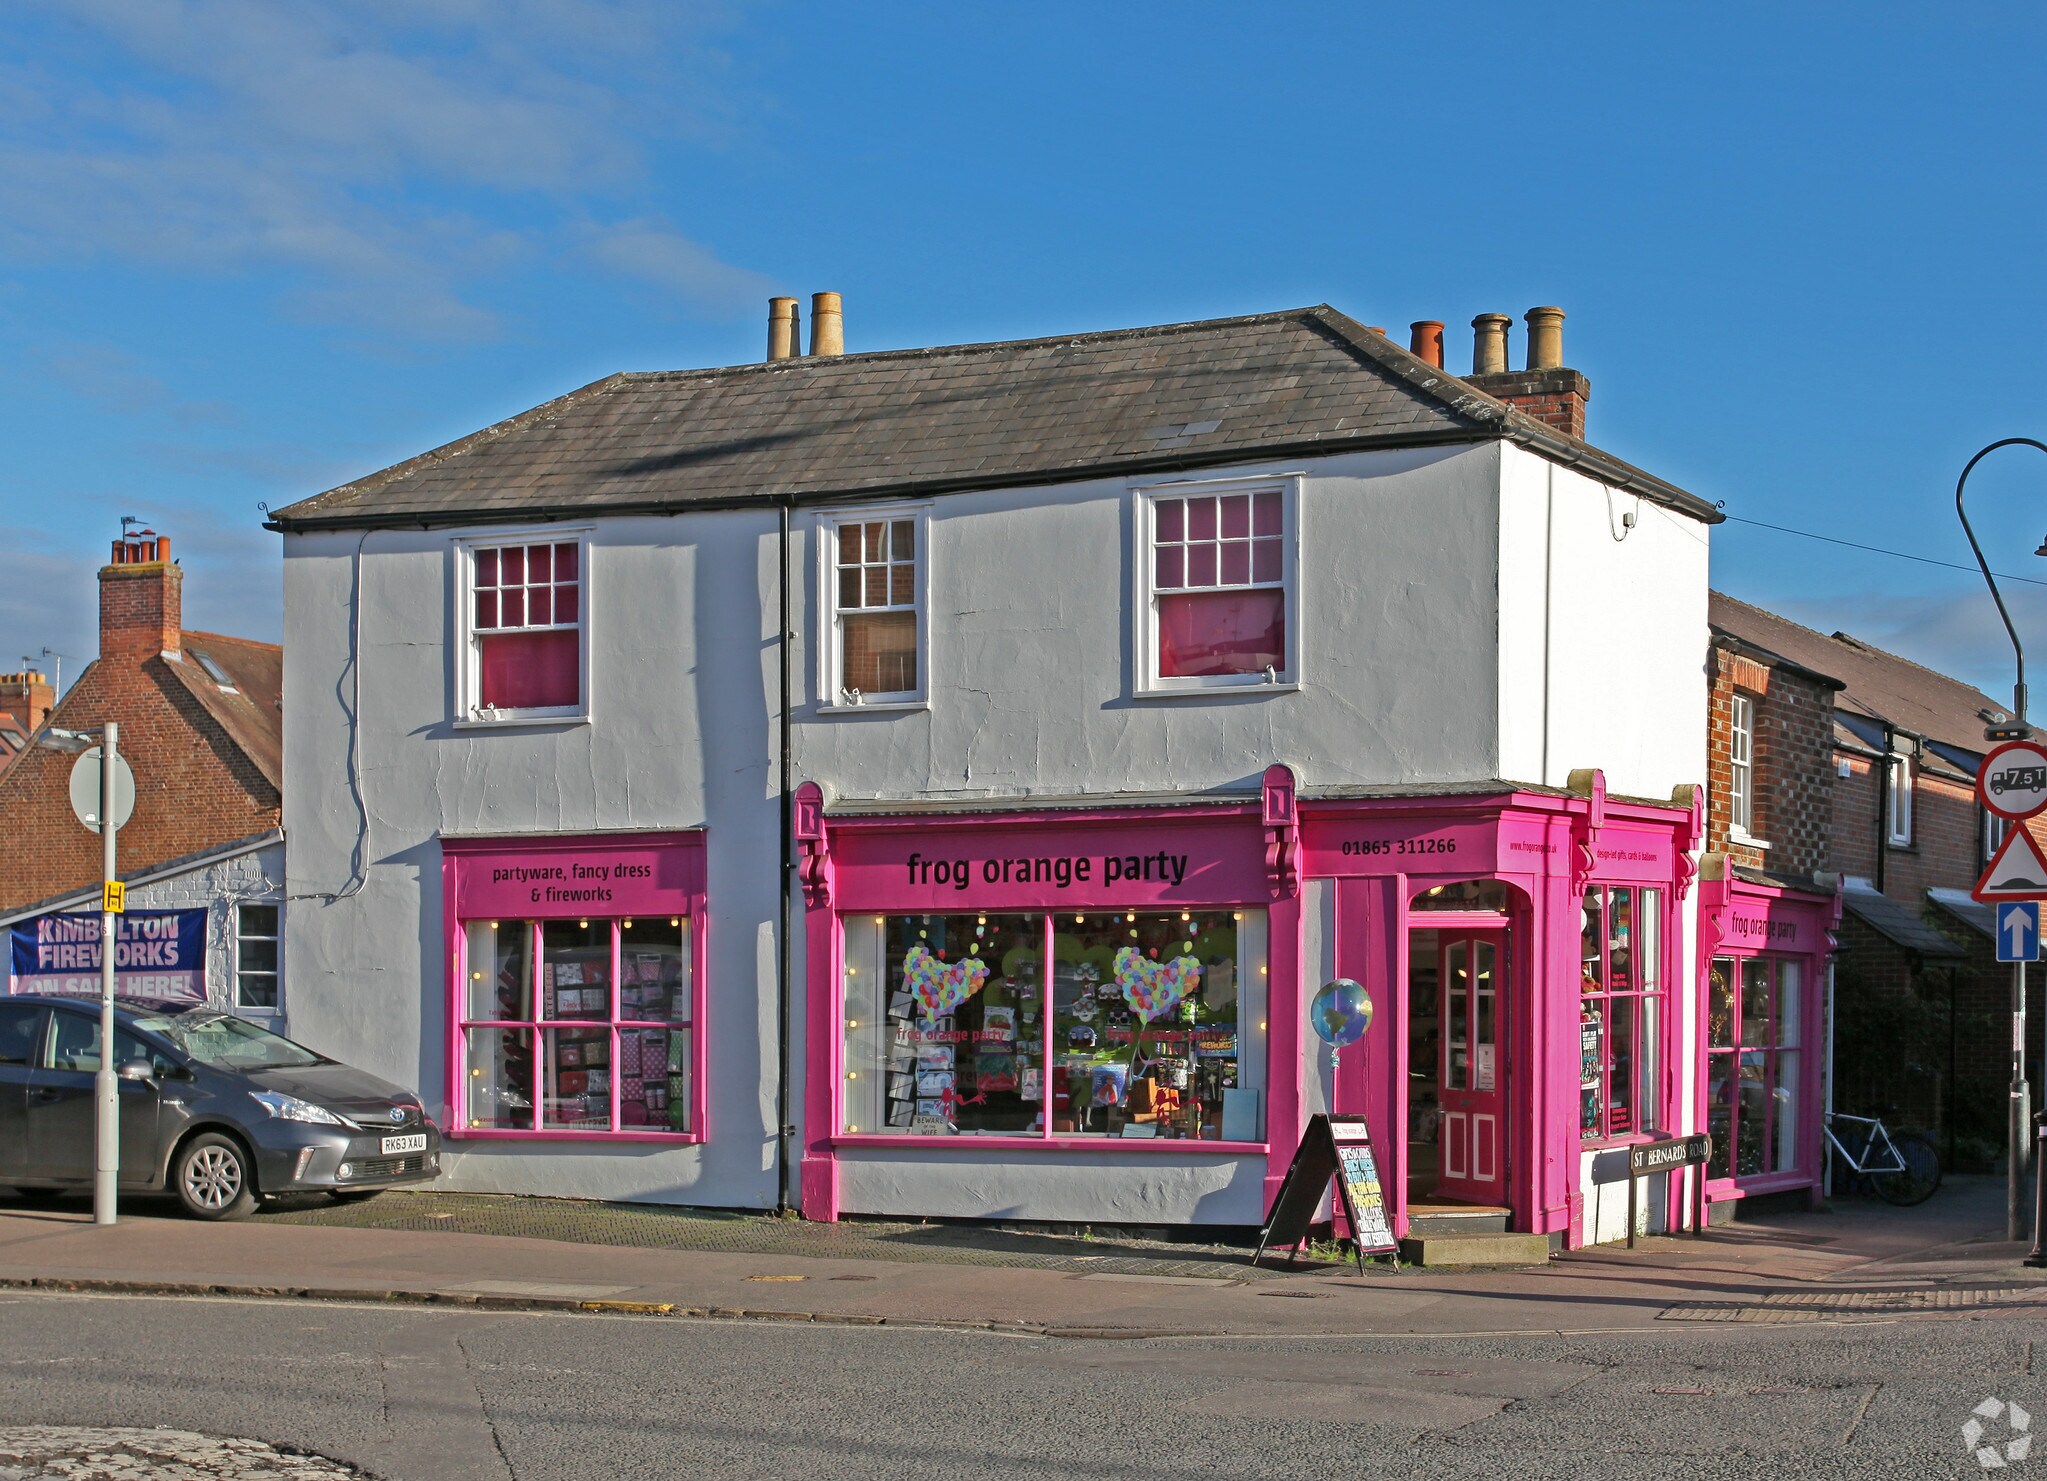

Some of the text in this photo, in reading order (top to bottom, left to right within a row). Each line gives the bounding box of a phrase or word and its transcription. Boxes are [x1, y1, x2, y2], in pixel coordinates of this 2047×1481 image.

[2008, 768, 2044, 785] 7.5 T
[1341, 838, 1456, 856] 01865 311266
[493, 862, 651, 884] partyware, fancy dress
[907, 850, 1188, 890] frog orange party
[531, 886, 612, 902] & fireworks
[37, 915, 179, 943] KIMBLTON
[1732, 911, 1796, 943] frog orange party
[896, 1027, 1004, 1043] frog orange party
[1107, 1028, 1134, 1043] frog
[1138, 1031, 1183, 1042] orange
[917, 1116, 944, 1124] BEWARE
[385, 1136, 424, 1152] RK63 XAU
[1634, 1141, 1708, 1167] ST BERNARD'S ROAD
[1358, 1206, 1383, 1220] BALLOONS
